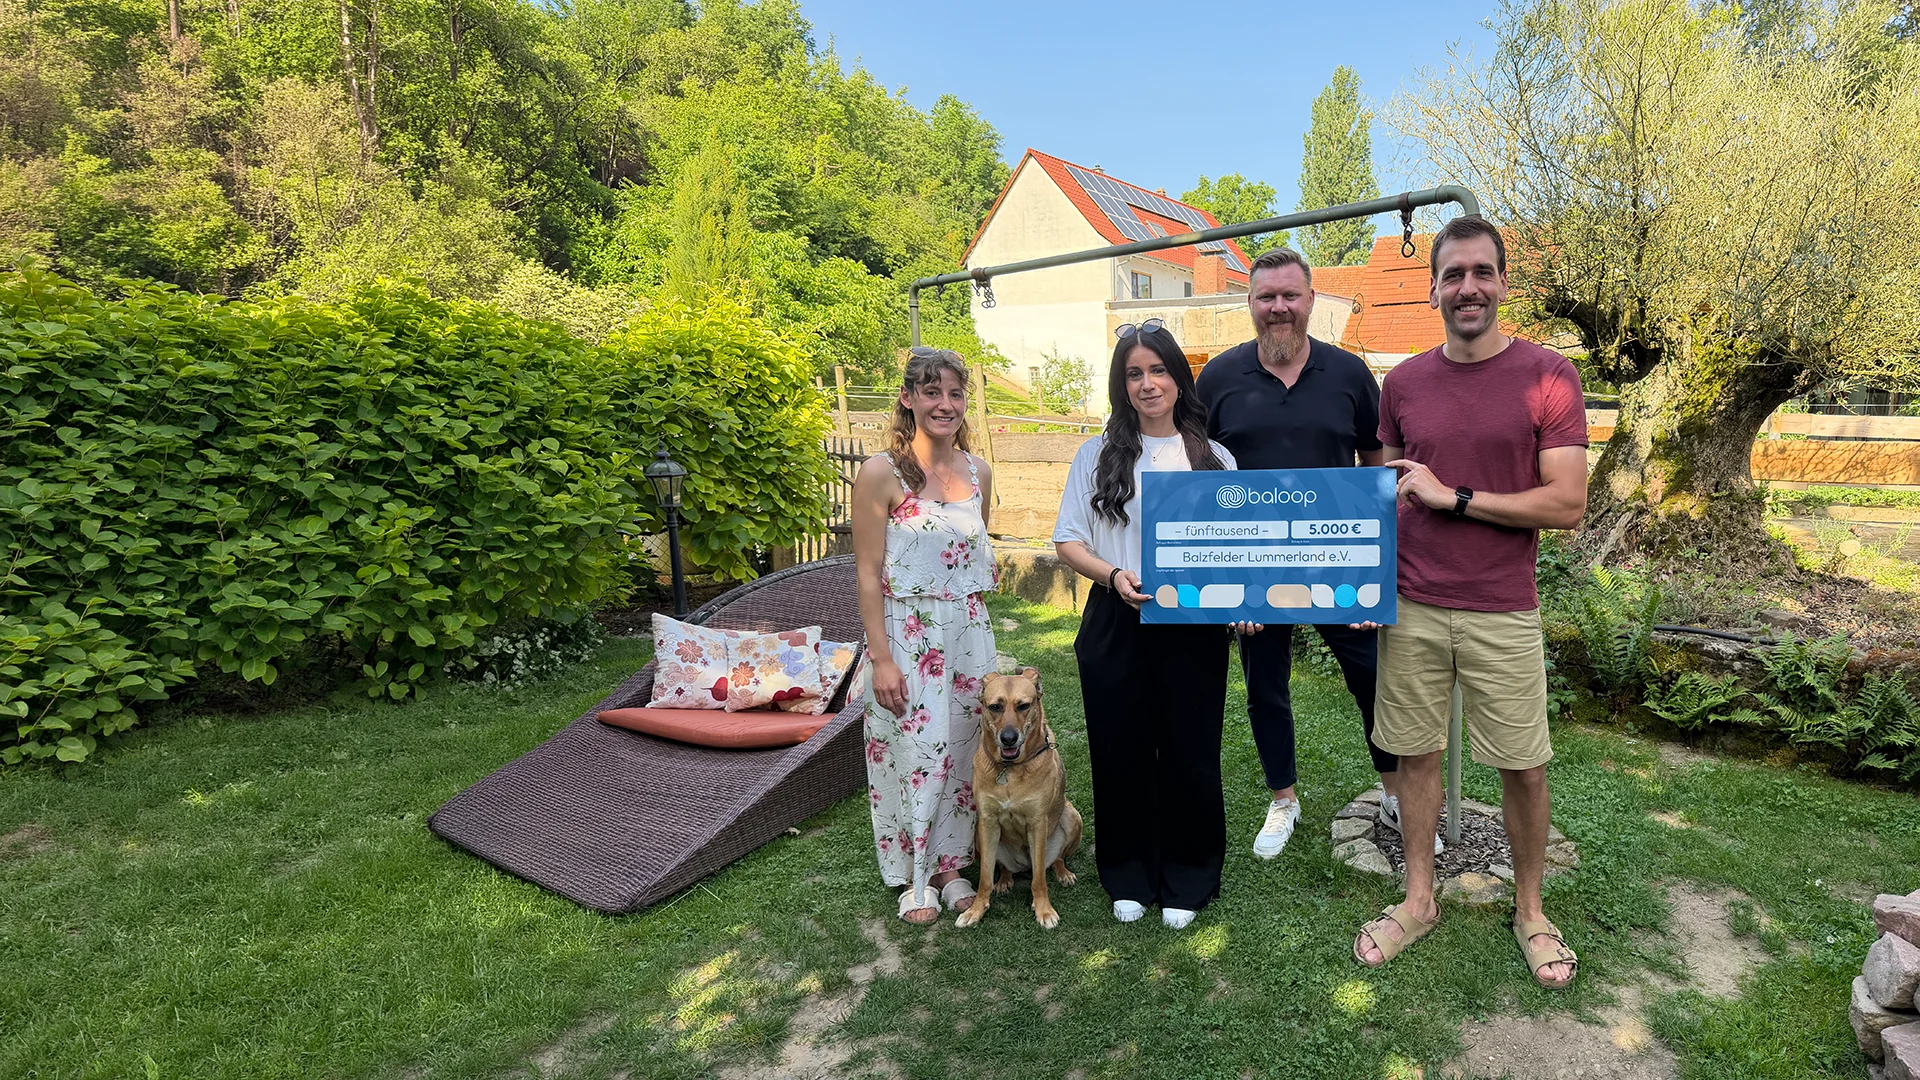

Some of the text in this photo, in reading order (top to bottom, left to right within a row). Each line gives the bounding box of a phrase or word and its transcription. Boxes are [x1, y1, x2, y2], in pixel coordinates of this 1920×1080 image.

[1248, 487, 1317, 508] baloop
[1185, 524, 1259, 537] fünftausend
[1309, 523, 1361, 535] 5.000 €
[1183, 550, 1352, 563] Balzfelder Lummerland e.V.
